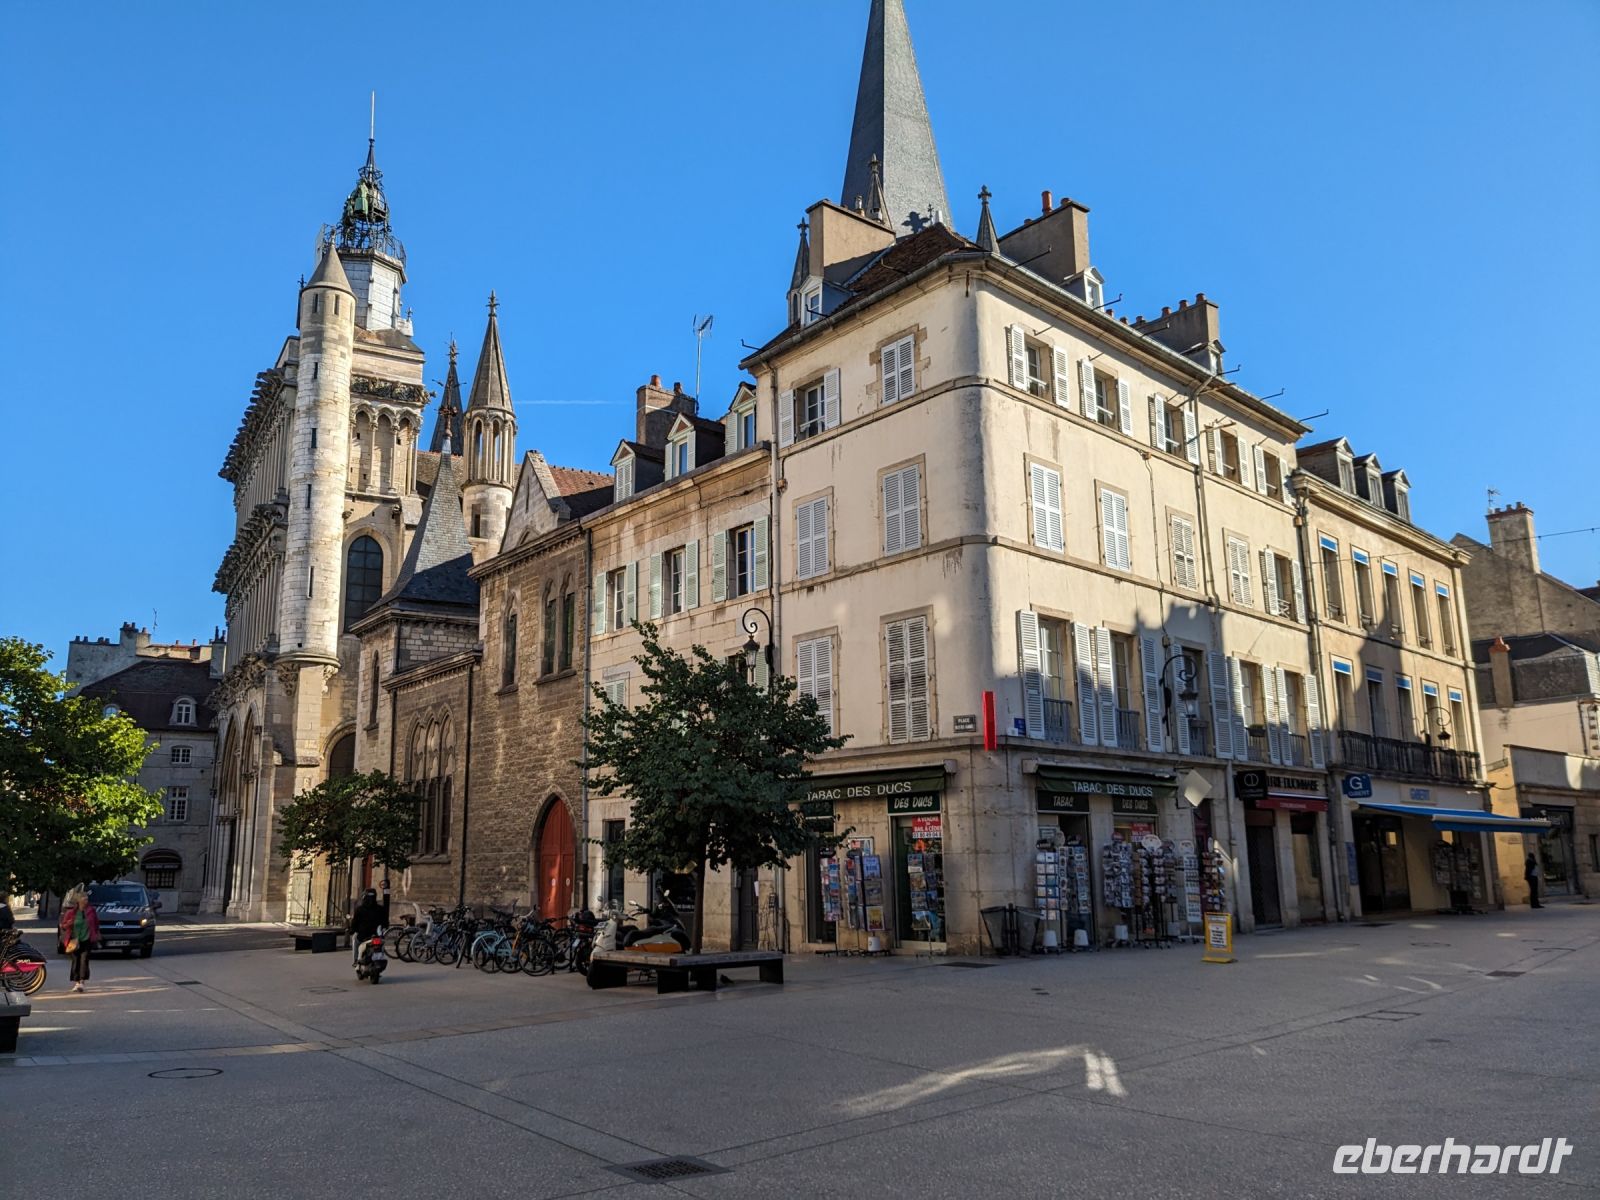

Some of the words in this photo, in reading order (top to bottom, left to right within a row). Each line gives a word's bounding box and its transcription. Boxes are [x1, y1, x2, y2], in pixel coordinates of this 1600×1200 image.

[1072, 781, 1102, 793] TABAC
[1107, 784, 1125, 795] DES
[1129, 786, 1153, 797] DUCS
[1349, 776, 1363, 790] G
[807, 789, 841, 801] TABAC
[847, 786, 871, 797] DES
[877, 782, 912, 795] DUCS
[894, 798, 910, 809] DES
[912, 796, 933, 808] DUCS
[1053, 796, 1074, 807] TABAC
[1122, 799, 1133, 809] DES
[1135, 800, 1148, 810] DUCS
